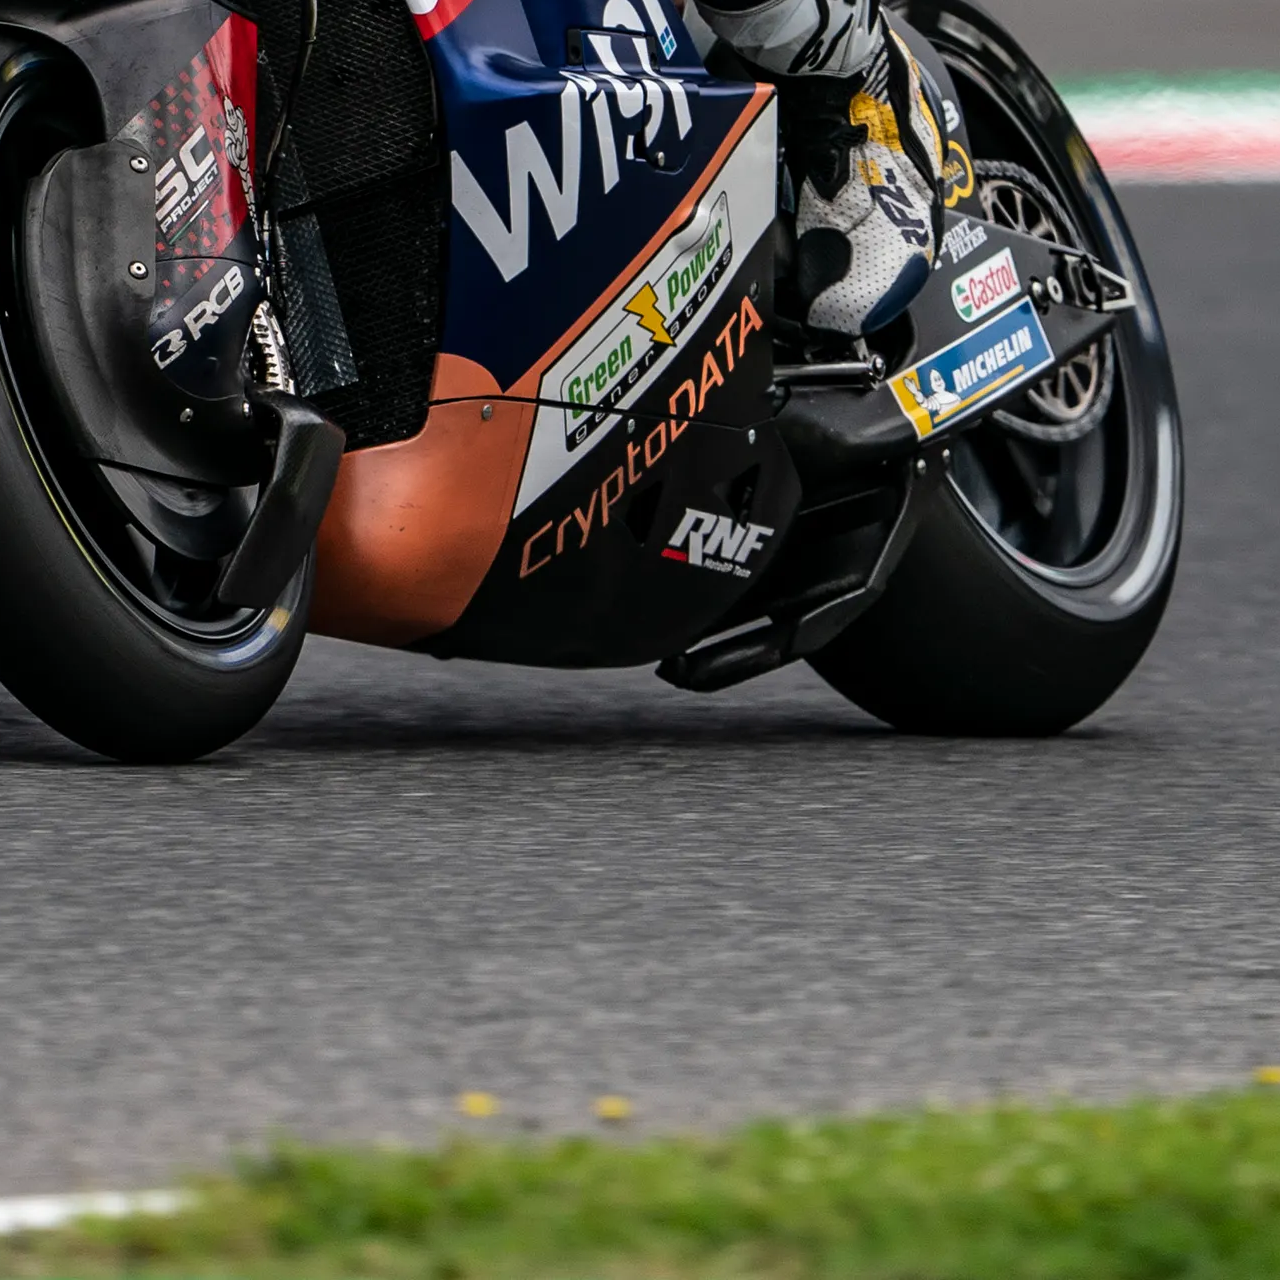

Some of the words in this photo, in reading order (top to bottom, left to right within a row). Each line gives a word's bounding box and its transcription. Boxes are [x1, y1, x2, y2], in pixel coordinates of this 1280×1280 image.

[160, 162, 220, 234] PROJECT
[666, 217, 724, 313] Power
[969, 255, 1018, 310] Castrol
[183, 264, 247, 343] RCB
[566, 333, 633, 420] Green
[952, 325, 1034, 393] MICHELIN
[519, 294, 765, 580] CryptoDATA
[667, 507, 776, 568] RNF
